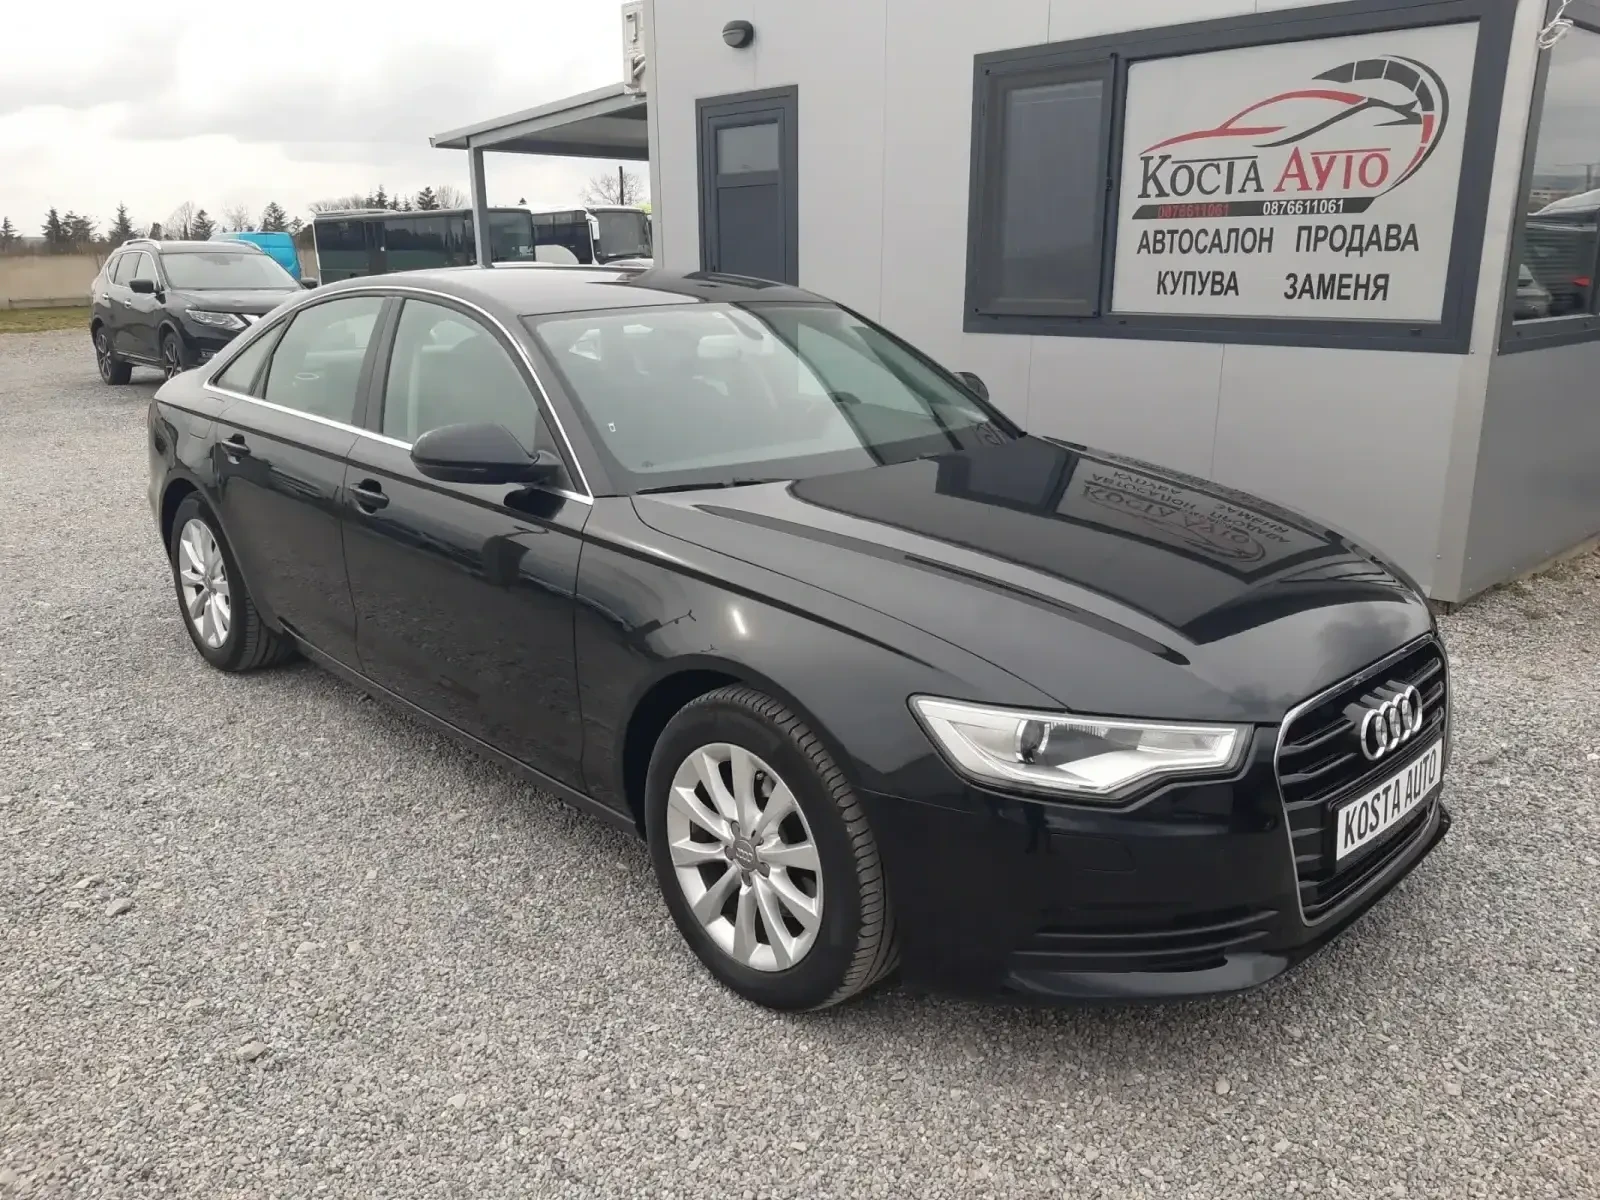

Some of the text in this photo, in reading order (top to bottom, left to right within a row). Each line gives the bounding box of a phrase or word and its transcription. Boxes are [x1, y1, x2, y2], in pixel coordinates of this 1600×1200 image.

[1262, 199, 1344, 216] 0876611061
[1137, 223, 1420, 257] АВТОСАЛОН ПРОДАВА
[1156, 270, 1390, 301] КУПУВА ЗАМЕНЯ
[1344, 750, 1437, 849] KOSTA AUTO
